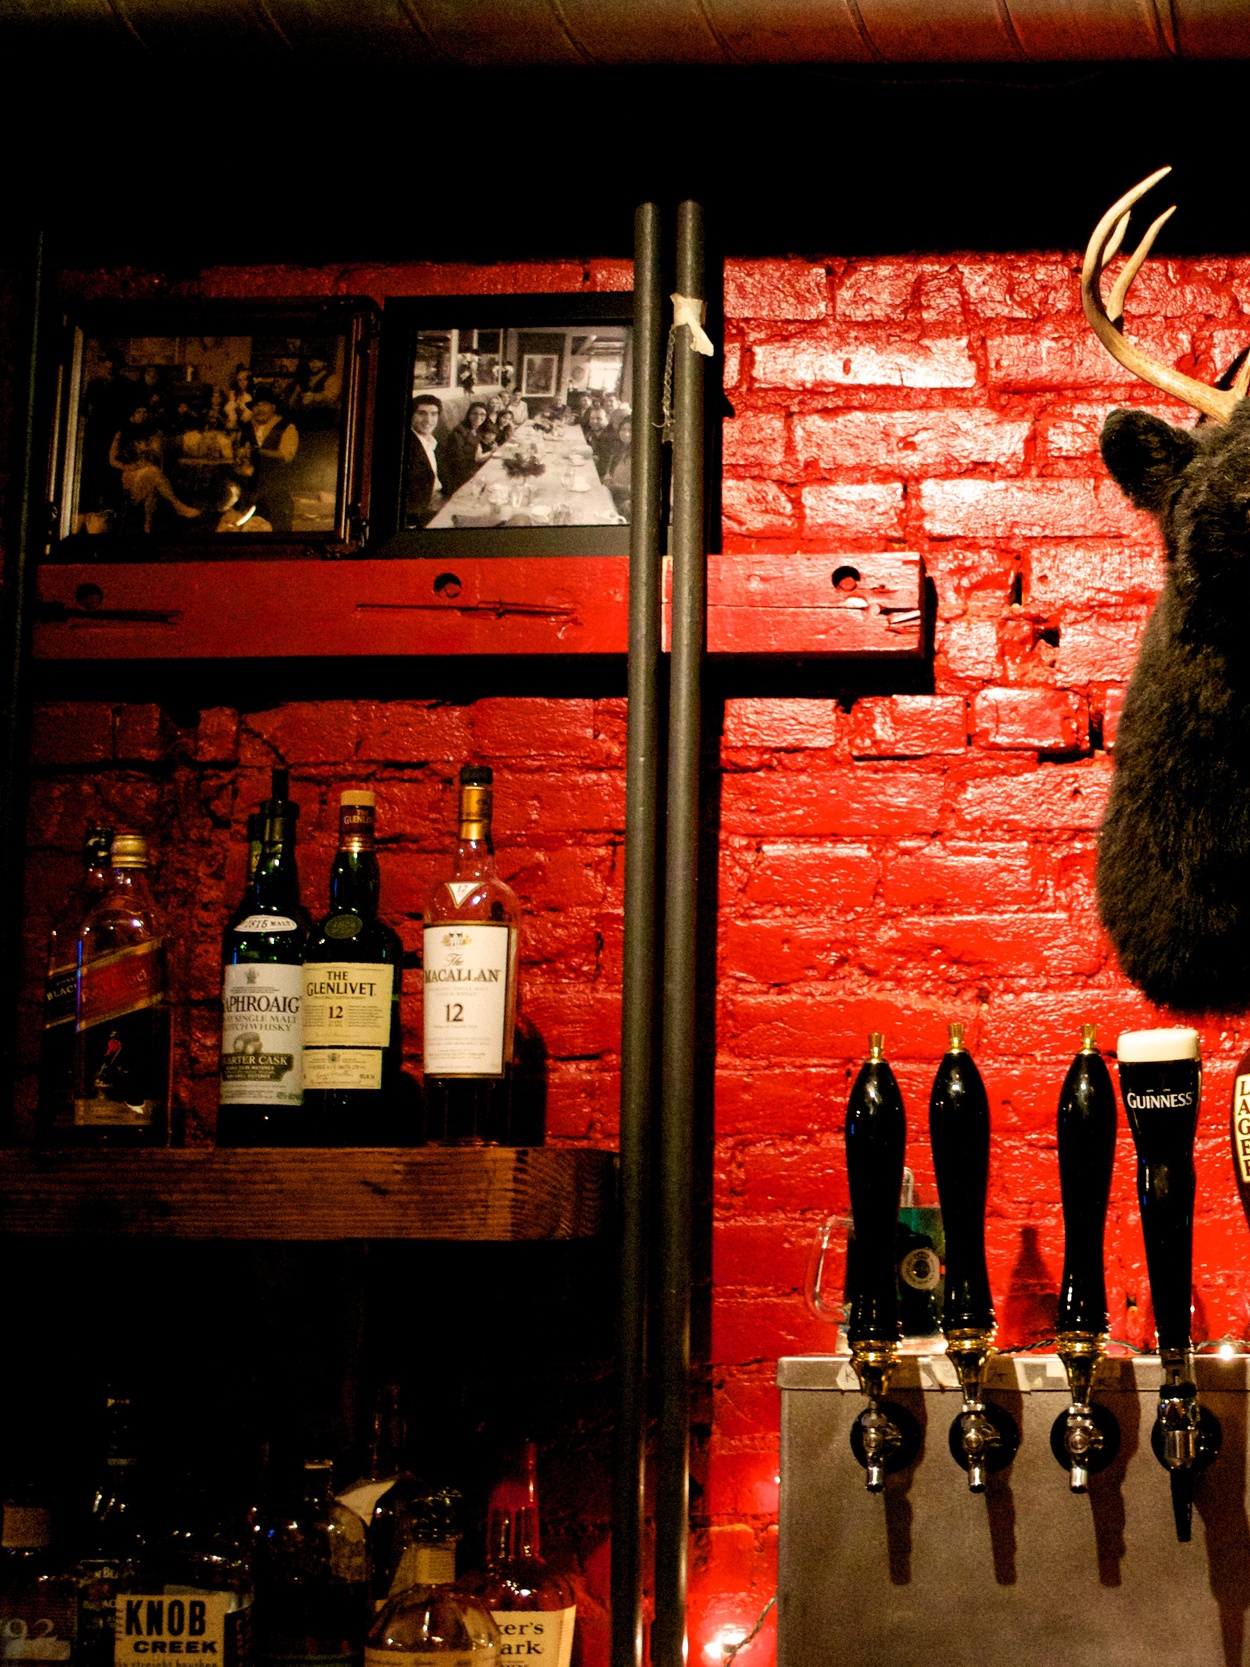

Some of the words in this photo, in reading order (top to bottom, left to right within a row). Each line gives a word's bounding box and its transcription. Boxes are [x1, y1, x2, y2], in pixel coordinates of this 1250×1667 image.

[326, 971, 349, 981] THE
[424, 968, 499, 984] MACALLAN
[306, 982, 377, 997] GLENLIVET
[223, 995, 300, 1014] APHROAIG
[328, 1005, 344, 1019] 12
[445, 1003, 464, 1022] 12
[258, 1055, 288, 1066] CASK
[1127, 1092, 1193, 1109] GUINNESS
[126, 1600, 206, 1636] KNOB
[134, 1641, 217, 1653] CREEK
[500, 1641, 542, 1654] ark
